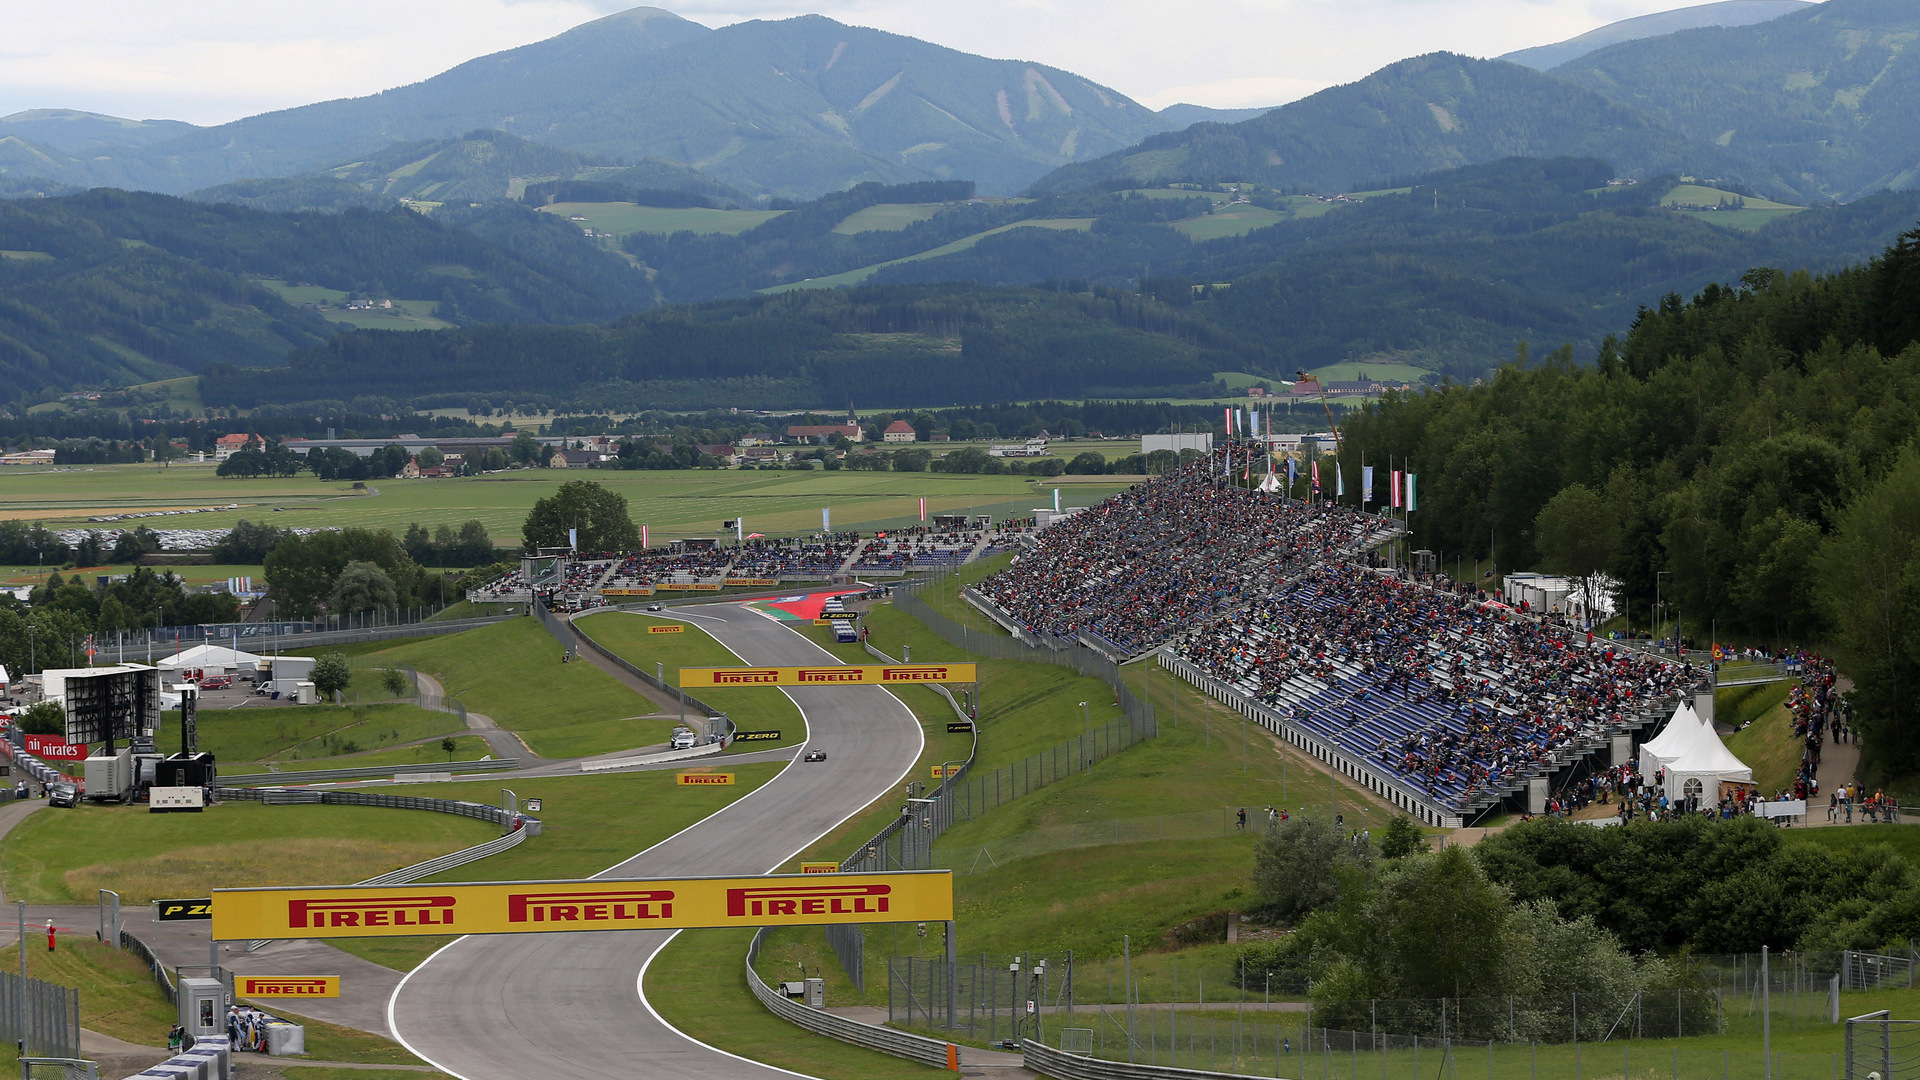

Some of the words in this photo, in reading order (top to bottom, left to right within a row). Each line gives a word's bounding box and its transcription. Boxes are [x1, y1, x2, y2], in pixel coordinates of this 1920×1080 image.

[713, 671, 779, 683] PIRELLI
[798, 669, 863, 682] PIRELLI
[883, 668, 948, 680] PIRELLI
[684, 775, 727, 783] PIRELLI
[165, 906, 183, 915] P
[288, 896, 456, 928] PIRELLI
[508, 890, 675, 922] PIRELLI
[727, 884, 891, 916] PIRELLI
[246, 980, 327, 994] PIRELLI
